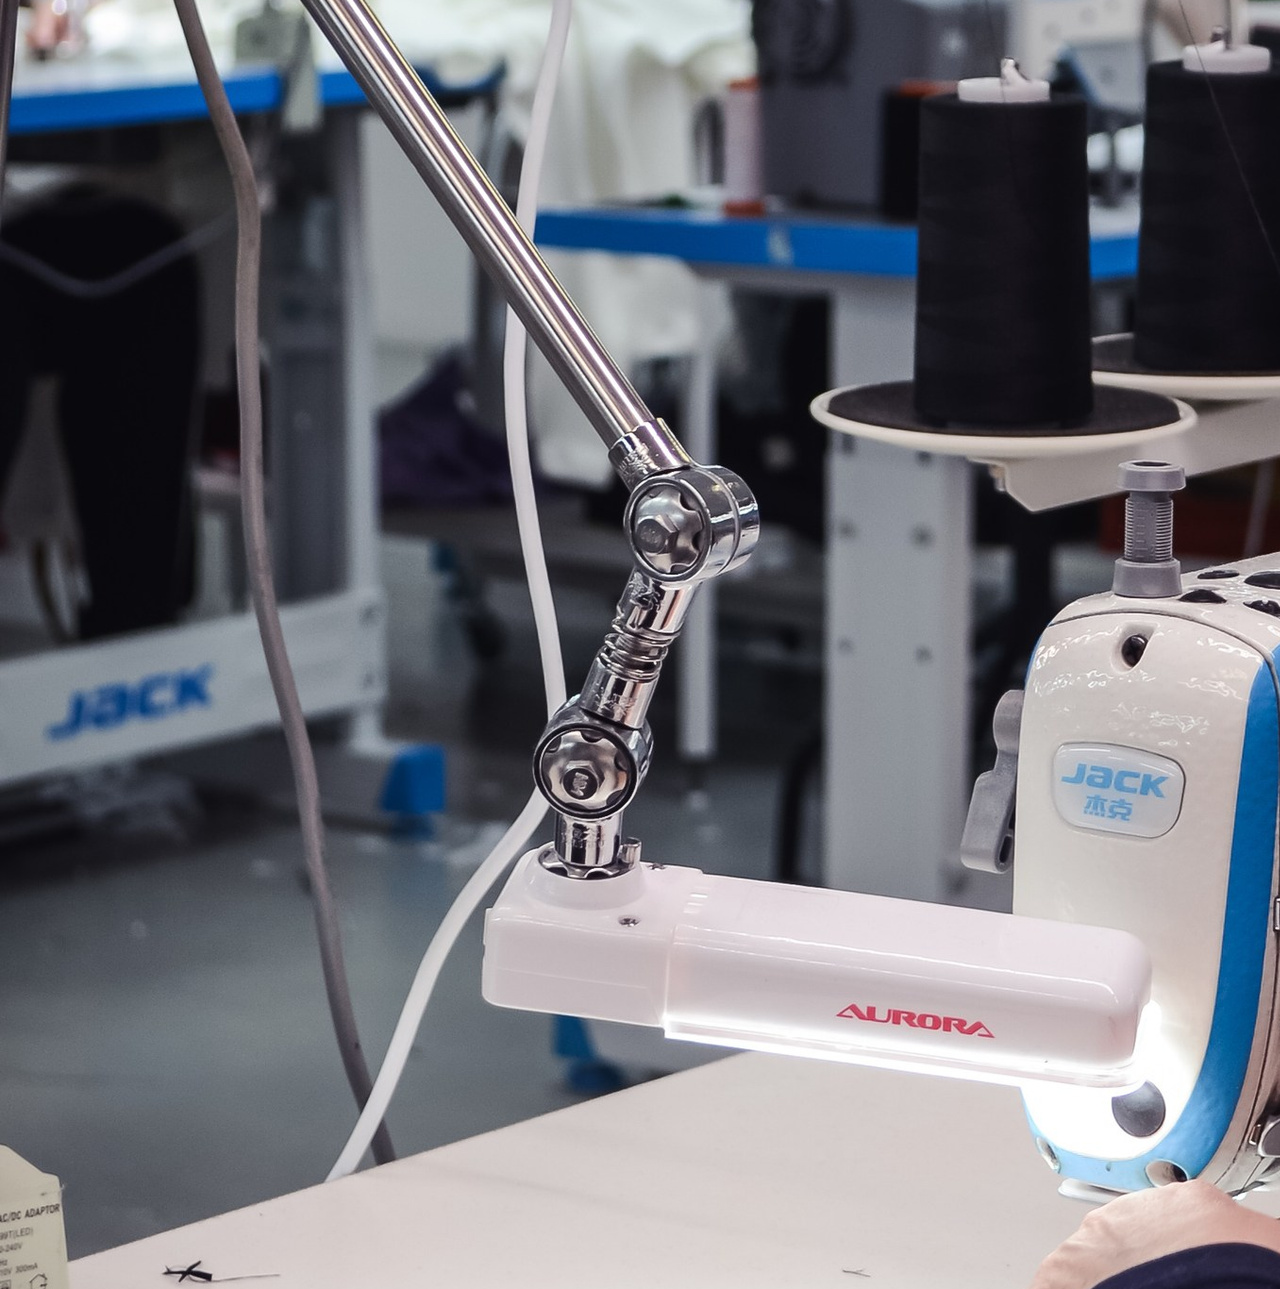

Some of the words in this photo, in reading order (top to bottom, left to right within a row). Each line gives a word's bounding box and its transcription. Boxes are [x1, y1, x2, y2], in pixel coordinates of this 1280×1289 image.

[1083, 795, 1134, 821] 杰克
[836, 1003, 996, 1038] AURORA
[25, 1203, 60, 1218] ADAPTOR
